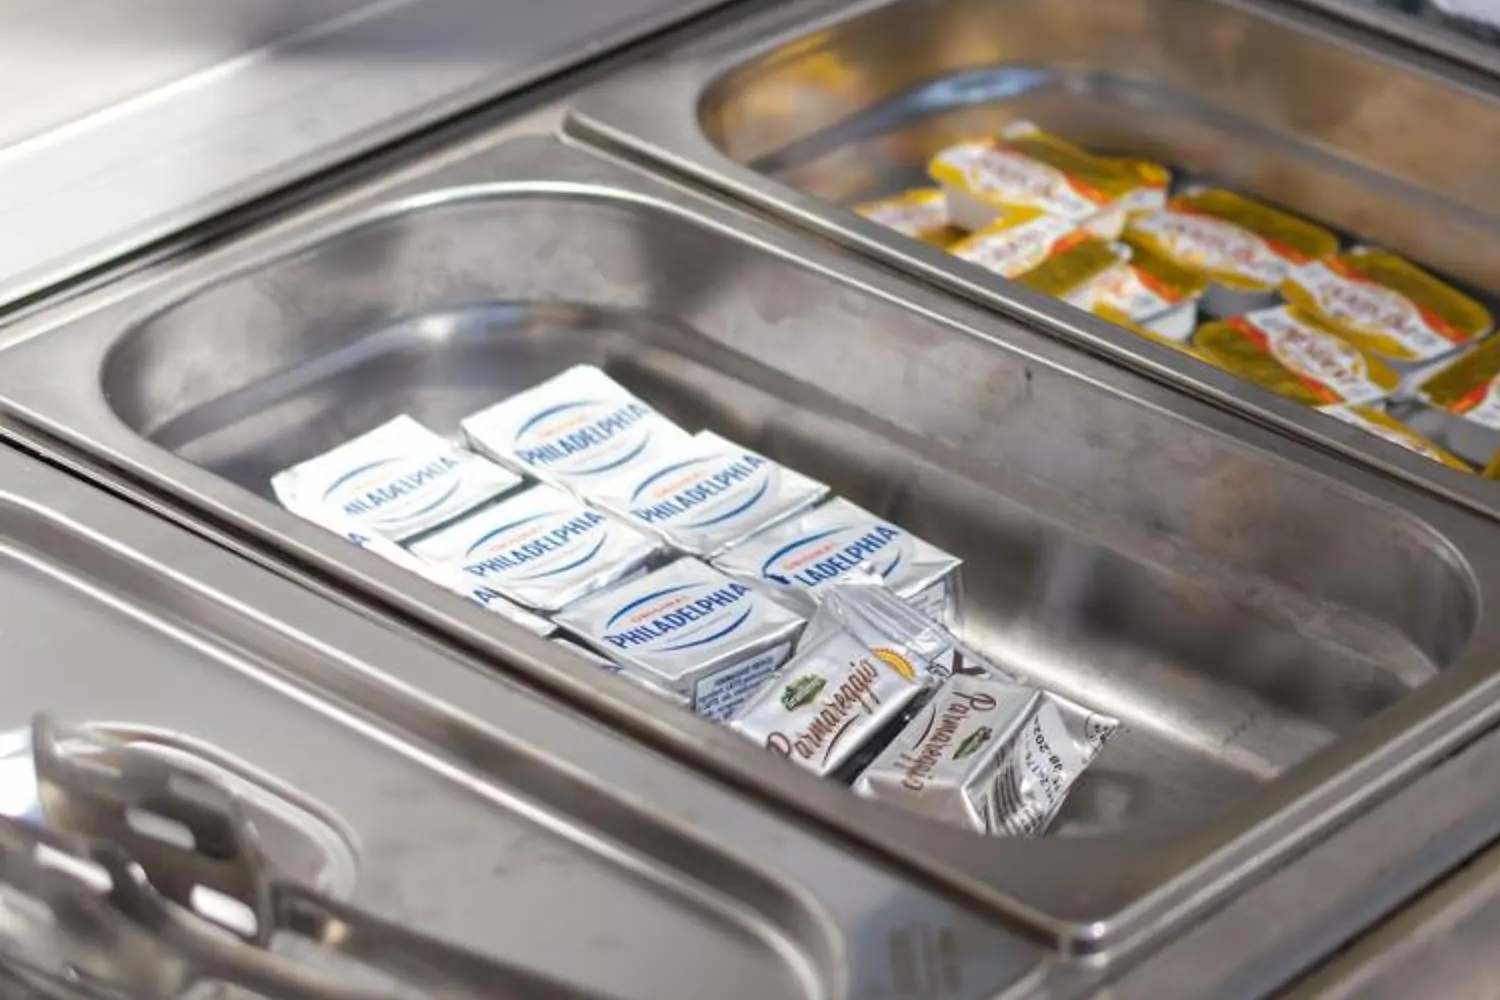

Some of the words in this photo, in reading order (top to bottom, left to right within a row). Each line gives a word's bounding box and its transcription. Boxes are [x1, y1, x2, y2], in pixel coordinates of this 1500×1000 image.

[514, 403, 651, 465] PHILADELPHIA
[343, 455, 460, 516] HILADELPHIA
[629, 454, 767, 523] PHILADELPHIA
[463, 511, 607, 577] PHILADELPHIA
[766, 525, 900, 587] LADELPHIA
[602, 581, 752, 649] PHILADELPHIA
[766, 658, 880, 759] Parmareggio
